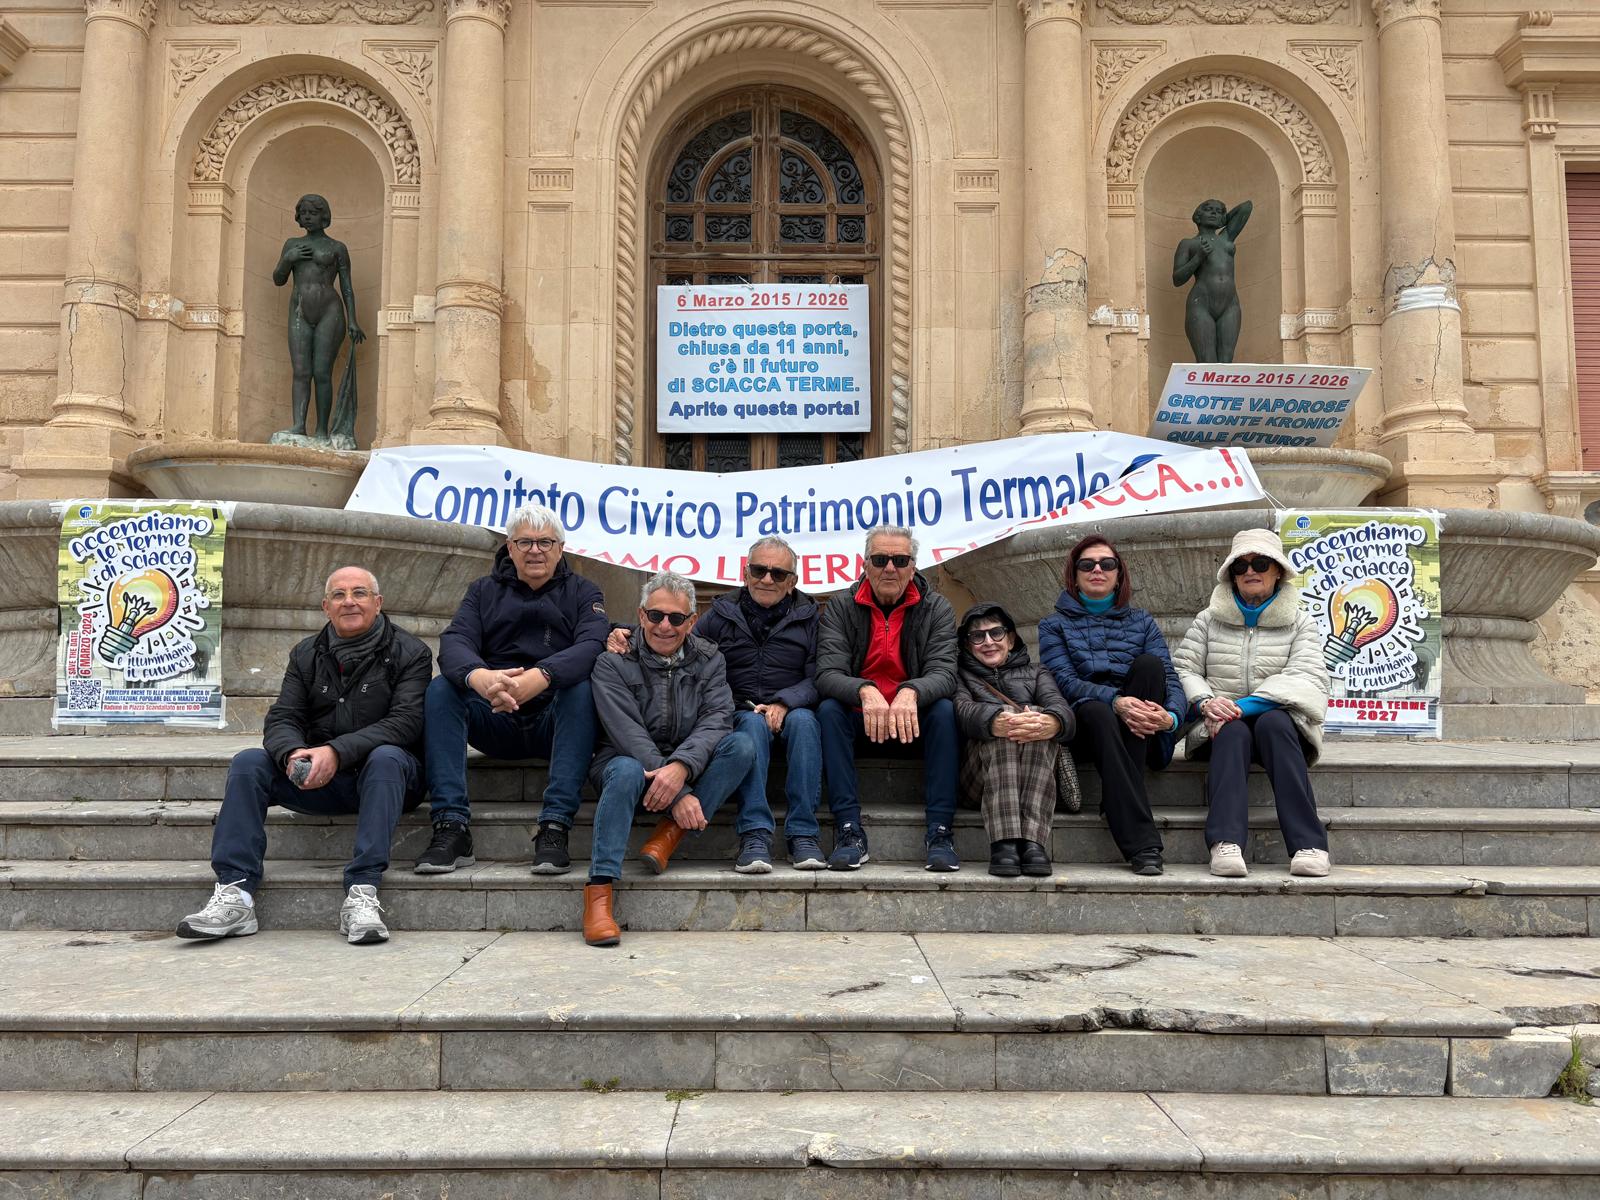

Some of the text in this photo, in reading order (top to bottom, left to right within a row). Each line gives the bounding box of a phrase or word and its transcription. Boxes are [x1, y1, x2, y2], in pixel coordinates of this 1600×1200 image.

[677, 292, 848, 307] 6 Marzo 2015 / 2026
[669, 321, 858, 339] Dietro questa porta,
[678, 339, 850, 357] chiusa da 11 anni,
[743, 358, 755, 373] il
[760, 358, 819, 373] futuro
[667, 376, 860, 393] di SCIACCA TERME.
[1187, 371, 1350, 387] 6 Marzo 2015 / 2026
[669, 400, 860, 420] Aprite questa porta!
[1167, 393, 1350, 414] GROTTE VAPOROSE
[1156, 410, 1343, 429] DEL MONTE KRONIO:
[1167, 431, 1317, 447] QUALE FUTURO?
[599, 485, 721, 539] Civico
[736, 475, 942, 538] Patrimonio
[71, 513, 208, 557] Accendiamo
[1291, 523, 1423, 568] Accendiamo
[96, 533, 186, 563] le Terme
[1316, 543, 1403, 573] le Terme
[101, 549, 192, 582] di Sciacca
[1320, 560, 1409, 592] di Sciacca
[82, 612, 92, 635] 2024
[68, 631, 79, 675] SAVE THE DATE
[80, 637, 91, 667] MARZO
[127, 643, 193, 667] illuminiamo
[127, 656, 192, 678] il futuro!
[1348, 653, 1414, 677] illuminiamo
[1348, 666, 1412, 688] il futuro!
[1327, 698, 1427, 711] SCIACCA TERME
[1356, 710, 1398, 722] 2027
